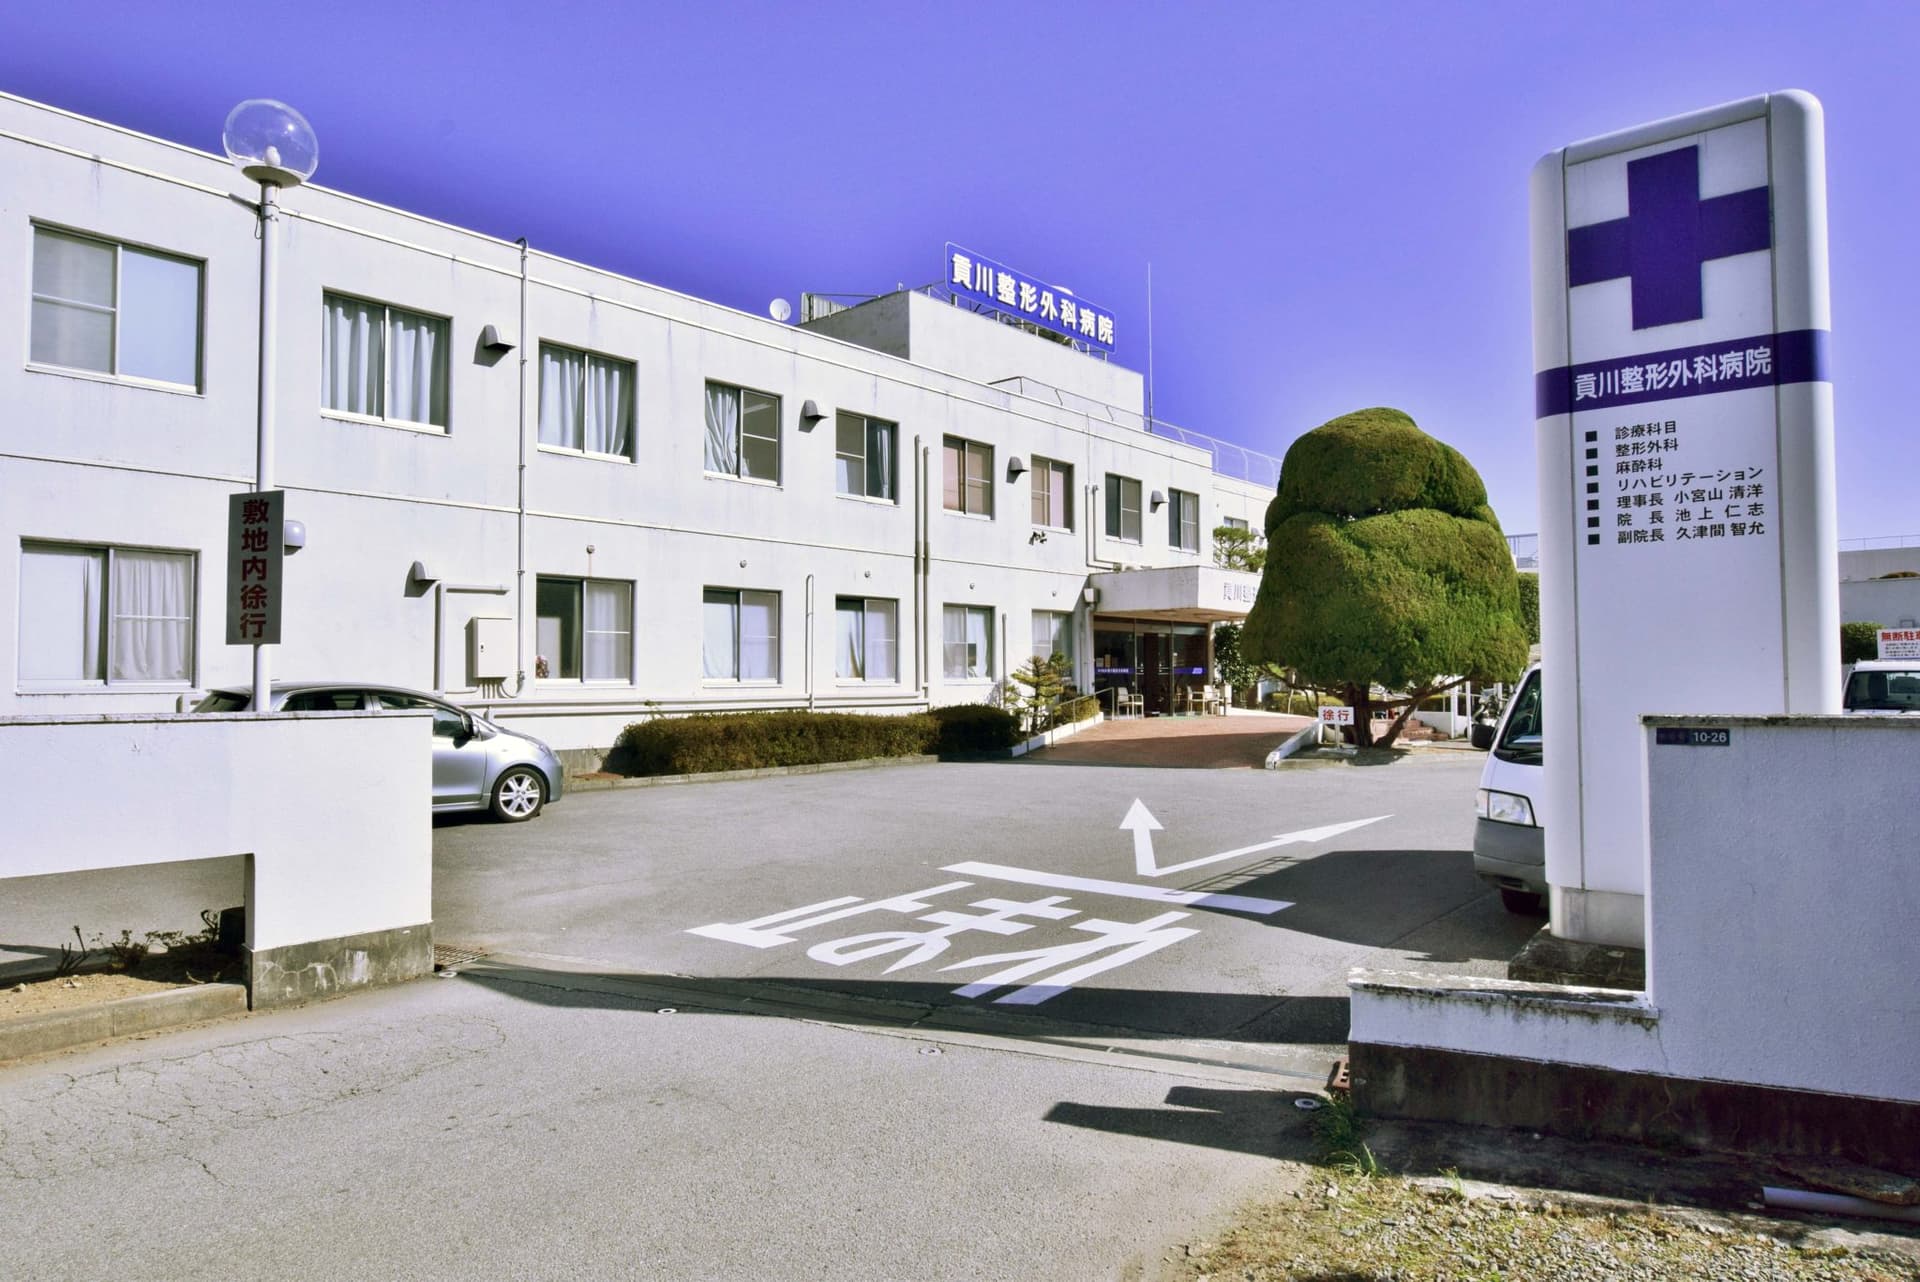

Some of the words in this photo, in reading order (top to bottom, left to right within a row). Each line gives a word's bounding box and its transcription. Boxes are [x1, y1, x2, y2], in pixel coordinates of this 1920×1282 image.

[951, 252, 1113, 345] 貢川整形外科病院
[1575, 346, 1772, 401] 貢川整形外科病院
[1615, 420, 1676, 440] 診療科目
[1615, 438, 1679, 457] 整形外科
[1616, 457, 1663, 474] 麻酔科
[1618, 467, 1763, 491] リハビリテーション
[1617, 492, 1663, 509] 理事長
[1674, 487, 1723, 504] 小宮山
[1617, 528, 1664, 544] 副院長
[1676, 524, 1725, 540] 久津間
[240, 498, 270, 639] 敷地内徐行
[1223, 582, 1258, 603] 貢川整
[1323, 709, 1349, 721] 徐行
[1694, 732, 1727, 743] 10-26
